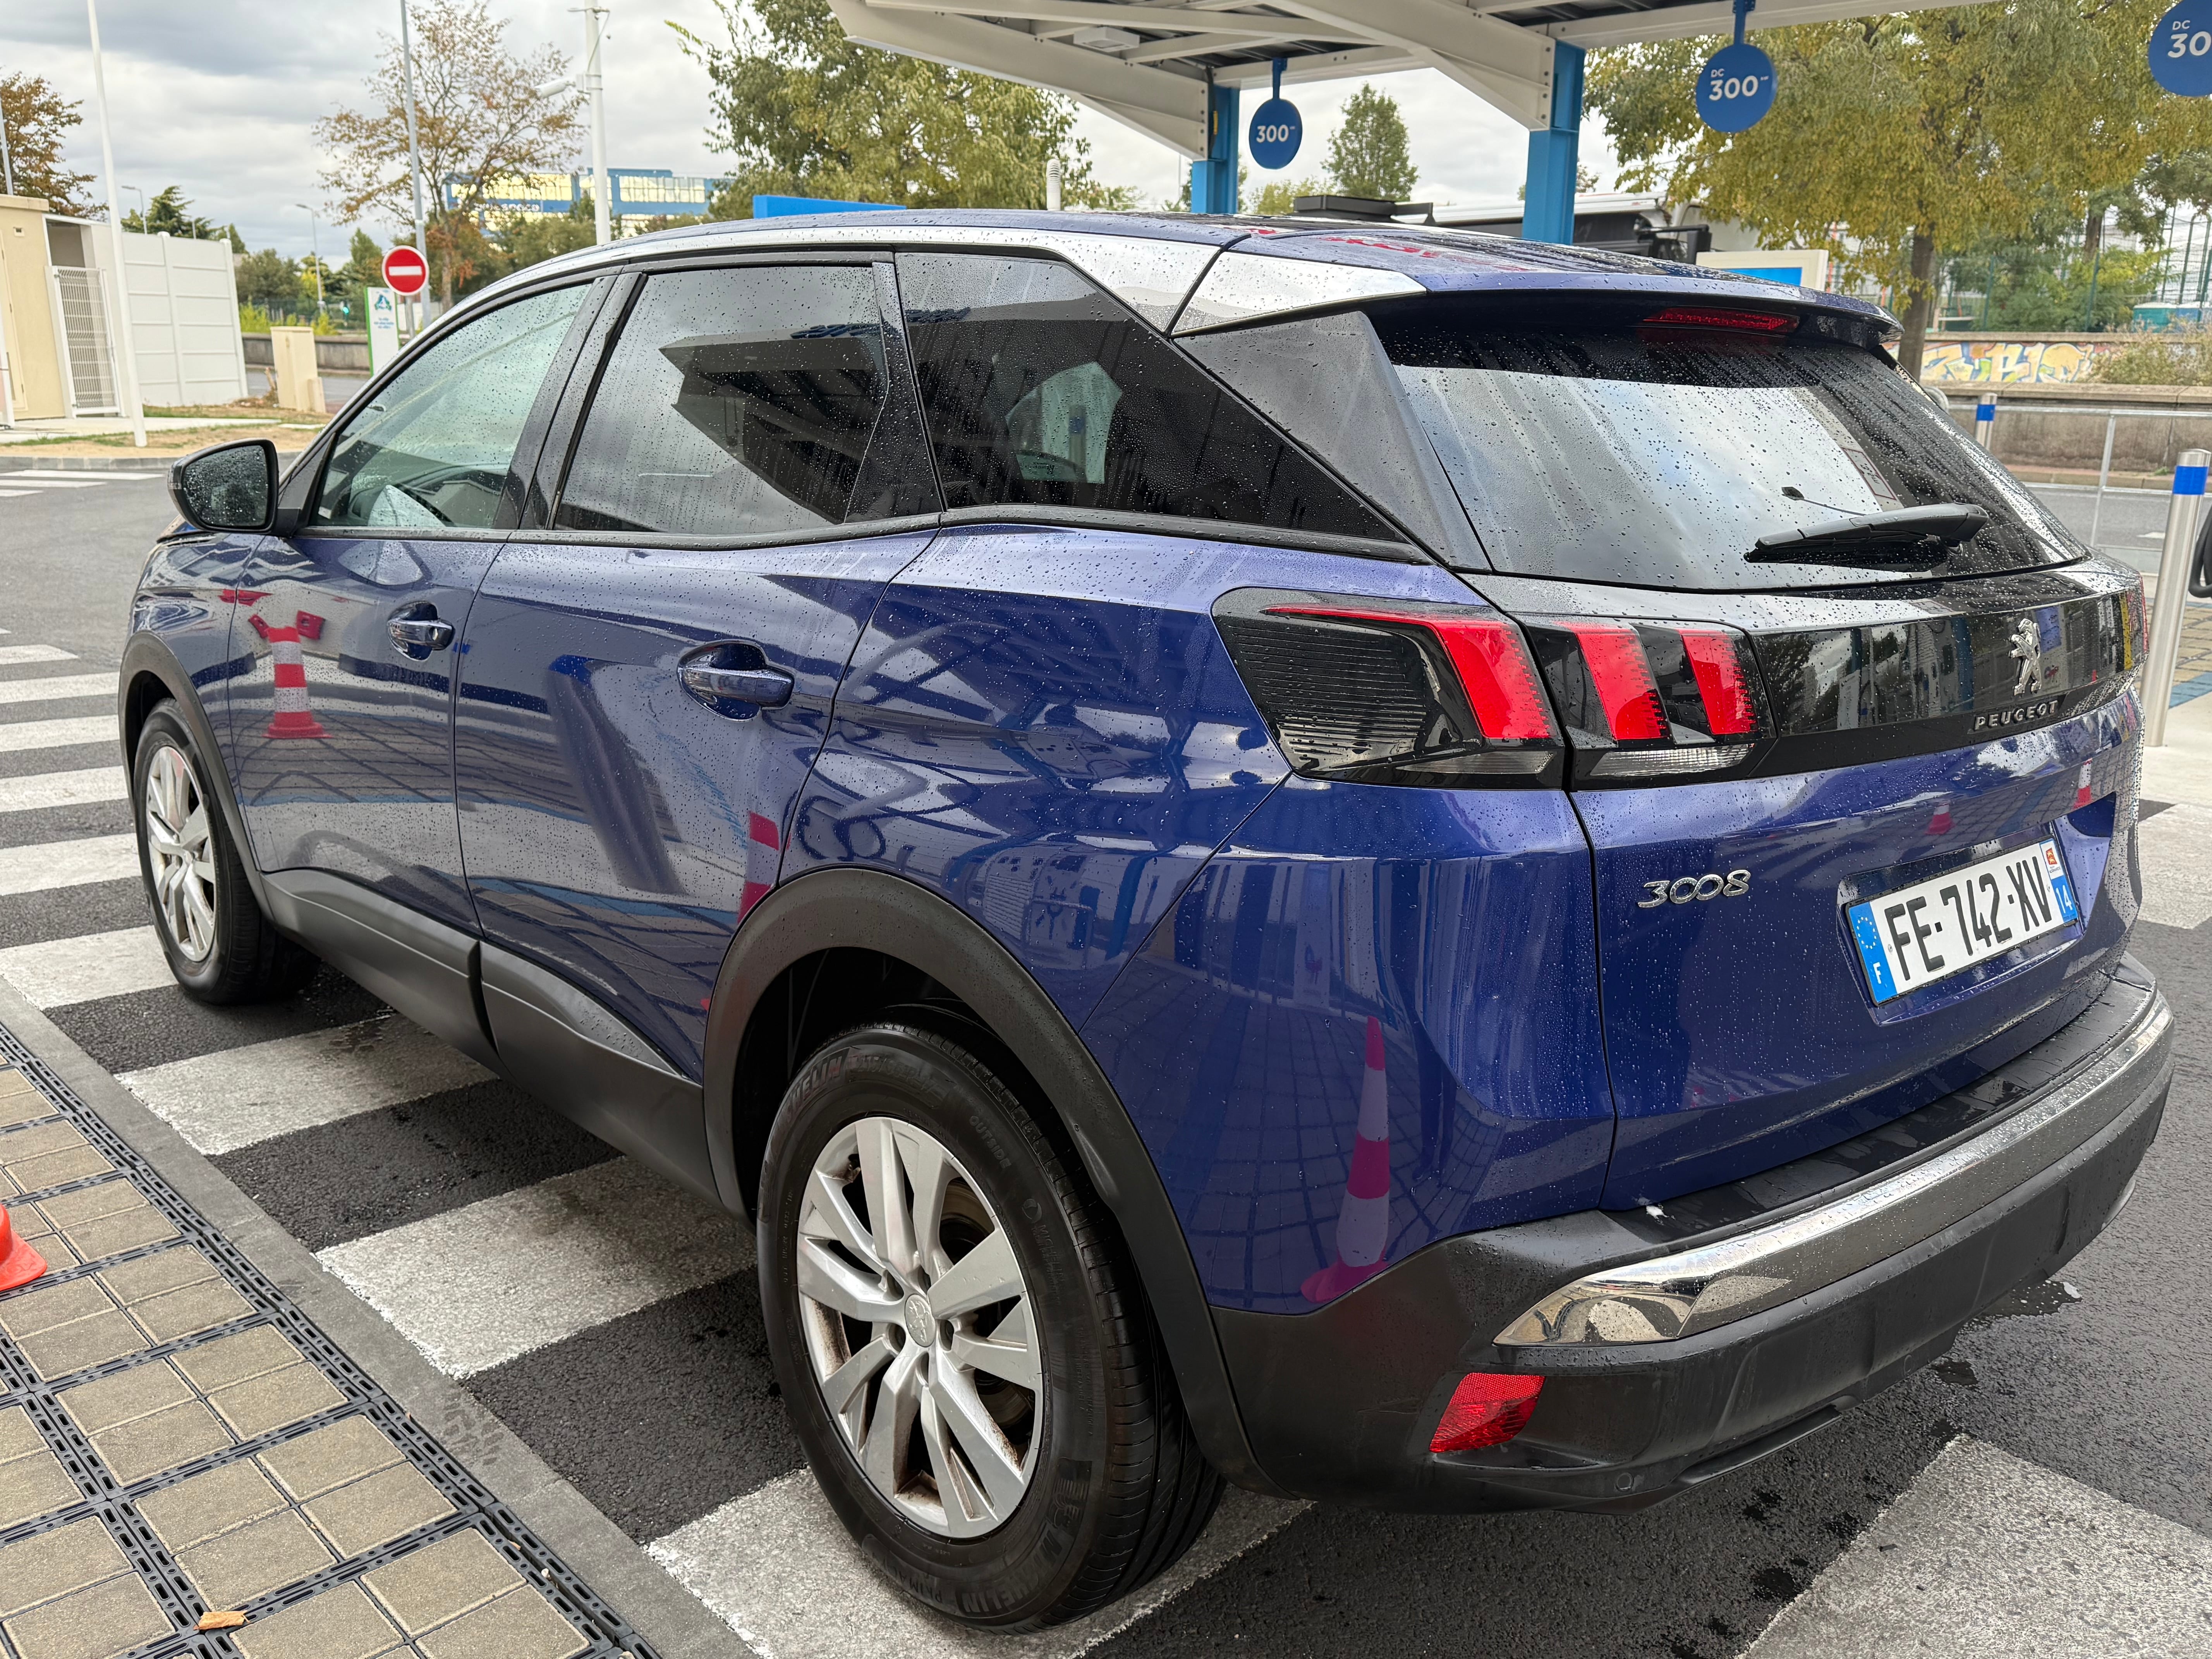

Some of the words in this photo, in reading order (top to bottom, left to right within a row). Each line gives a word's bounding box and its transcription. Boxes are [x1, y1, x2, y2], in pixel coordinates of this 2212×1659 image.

[2172, 20, 2191, 30] DC
[1711, 68, 1725, 77] DC
[1709, 76, 1759, 101] 300
[1256, 125, 1289, 143] 300
[1974, 700, 2058, 730] PEUGEOT
[1637, 869, 1751, 908] 3008
[2056, 884, 2073, 914] 14
[1884, 856, 2052, 981] FE-742-XV
[1872, 962, 1882, 984] F
[969, 1115, 1012, 1170] OUTSIDE
